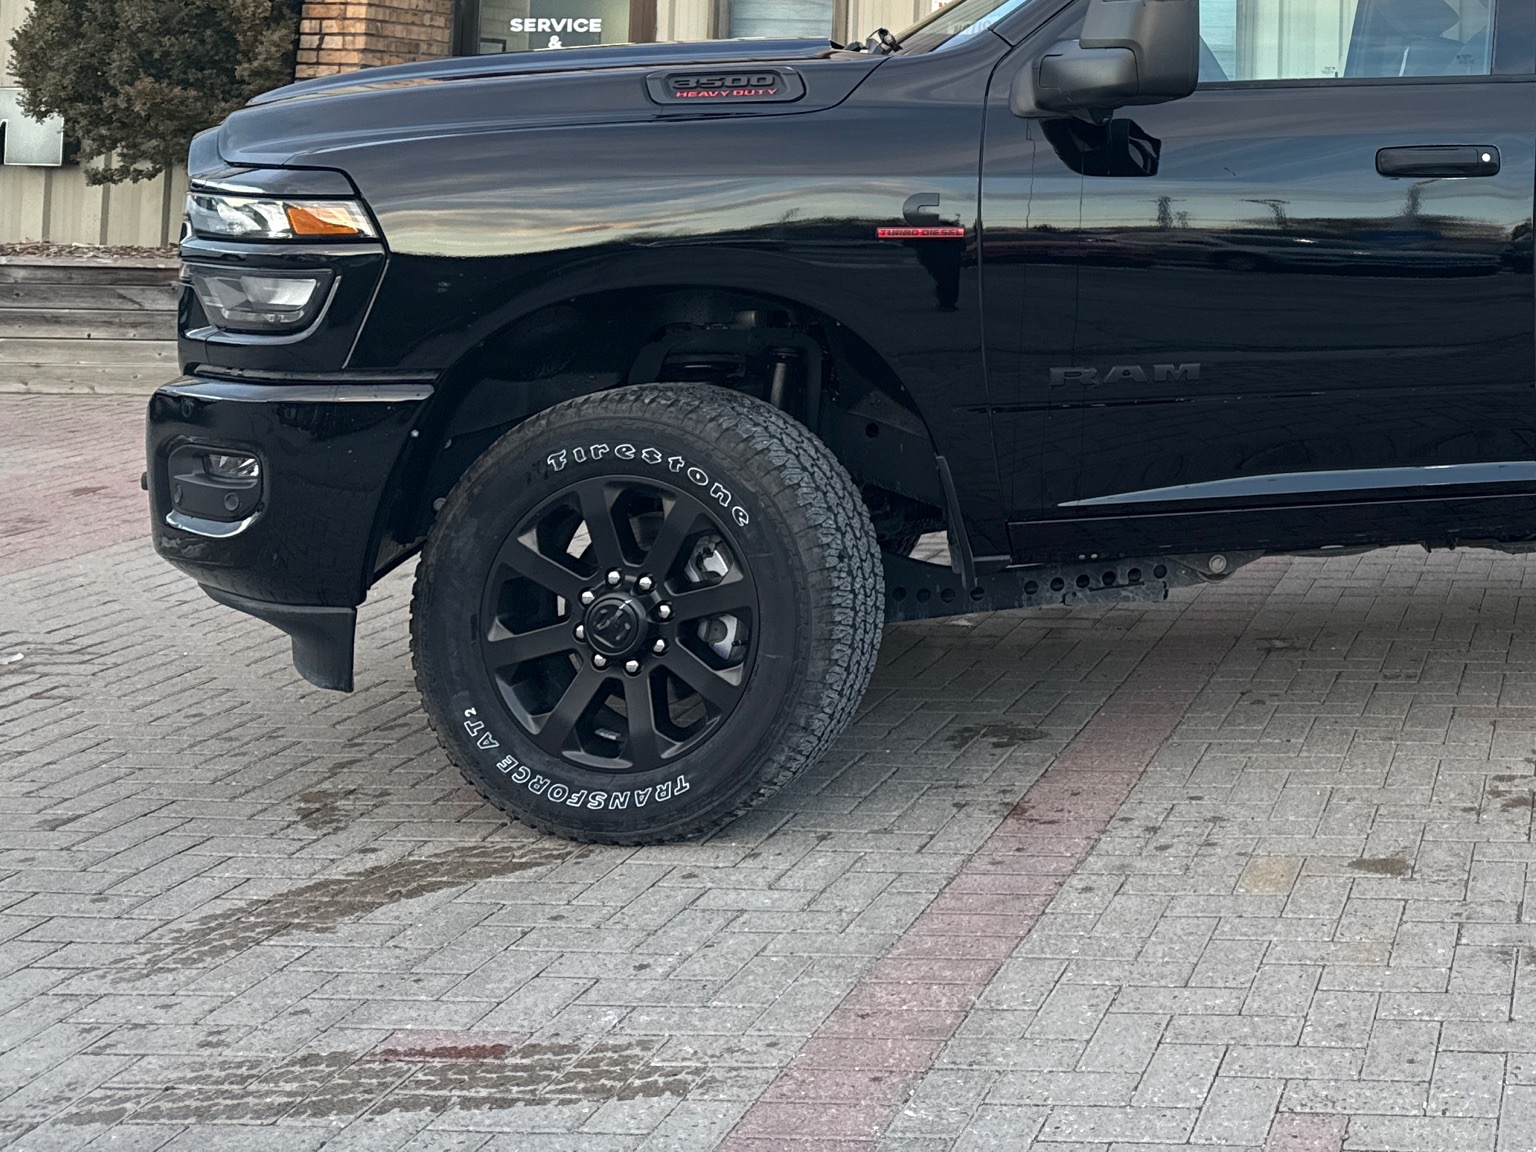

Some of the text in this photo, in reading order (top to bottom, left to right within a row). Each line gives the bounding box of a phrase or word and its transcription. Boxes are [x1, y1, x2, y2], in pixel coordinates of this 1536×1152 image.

[510, 17, 602, 33] SERVICE
[548, 35, 562, 48] &
[673, 75, 776, 90] 3500
[675, 88, 778, 98] HEAVY DUTY
[1049, 363, 1201, 387] RAM
[547, 443, 749, 527] Firestone
[496, 753, 690, 810] TRANSFORCE
